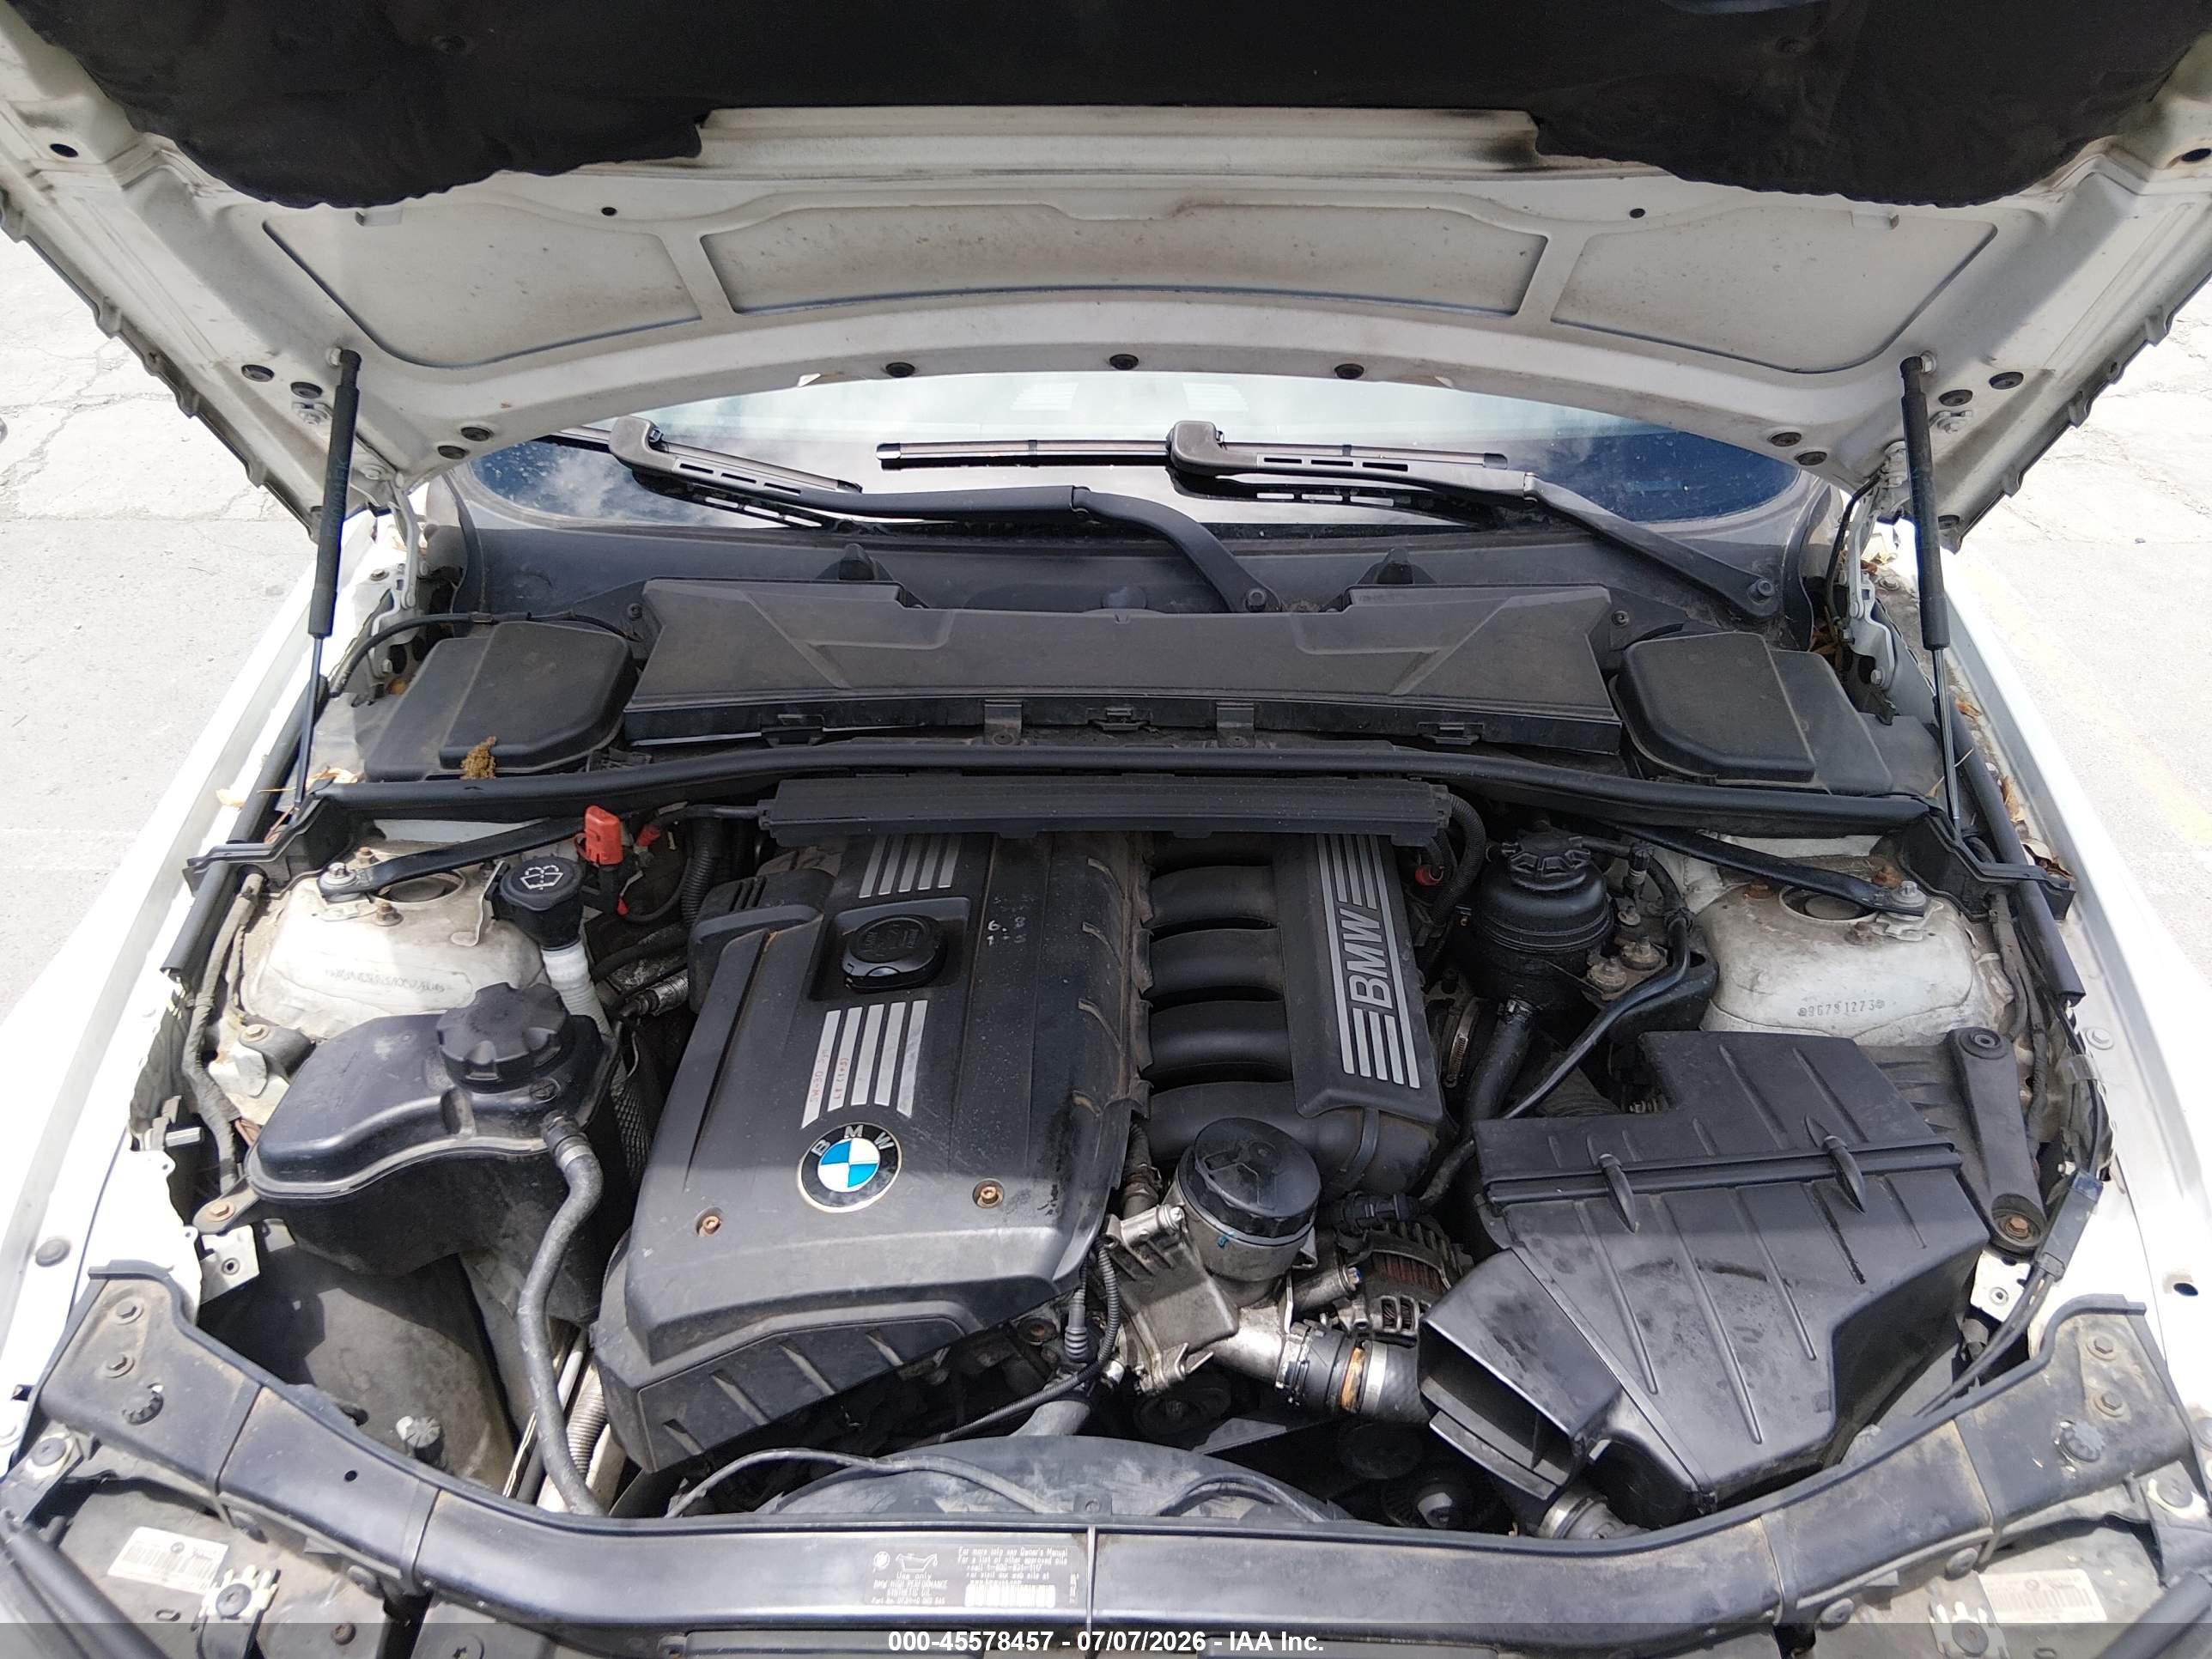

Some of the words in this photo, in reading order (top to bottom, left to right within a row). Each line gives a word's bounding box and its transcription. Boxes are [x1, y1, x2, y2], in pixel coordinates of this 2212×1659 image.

[1339, 908, 1394, 1009] BMW
[811, 1124, 895, 1157] BMW
[1020, 1547, 1044, 1556] Owner's
[1047, 1547, 1068, 1557] Manual
[896, 1571, 911, 1580] Use
[915, 1571, 933, 1581] only
